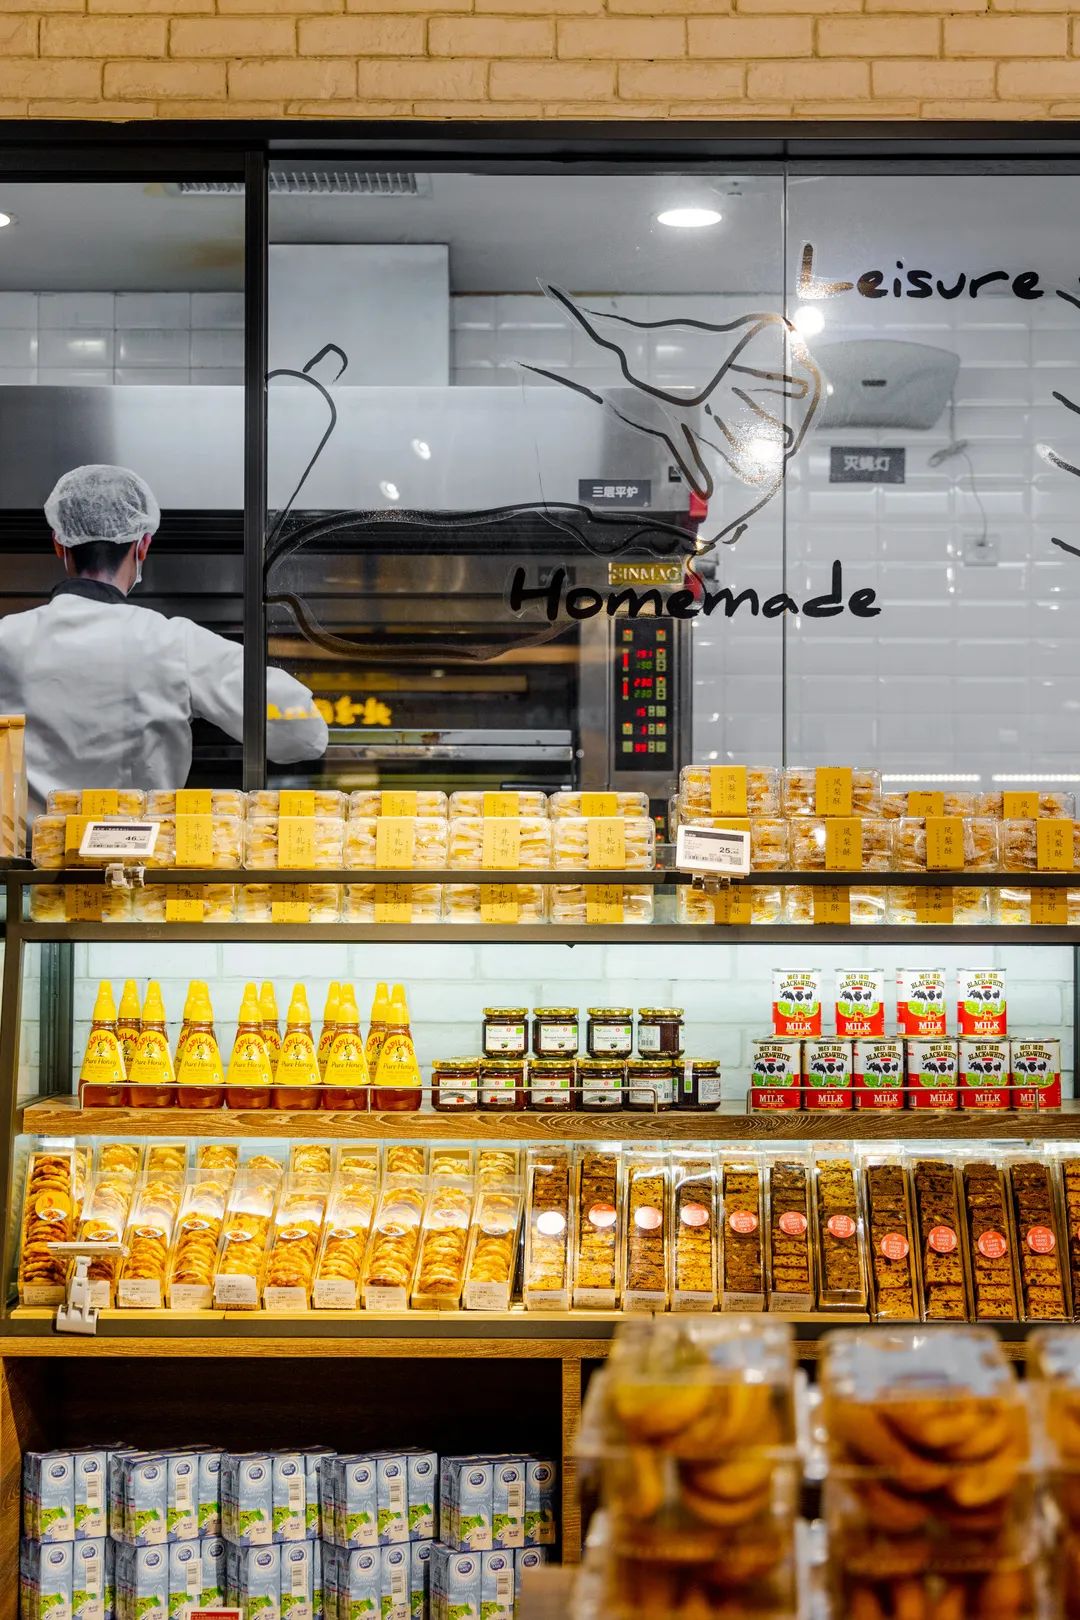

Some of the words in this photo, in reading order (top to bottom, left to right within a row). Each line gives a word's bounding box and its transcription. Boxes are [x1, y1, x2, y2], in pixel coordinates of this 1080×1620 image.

[801, 242, 1045, 299] Leisure
[592, 486, 639, 498] 三层平炉
[510, 560, 883, 619] Homemade
[786, 1021, 812, 1031] MILK
[845, 1021, 872, 1031] MILK
[918, 1021, 942, 1030] MILK
[973, 1021, 1000, 1030] MILK
[88, 1035, 116, 1051] CAPILANO
[137, 1036, 165, 1052] CAPILANO
[186, 1037, 216, 1053] CAPILANO
[235, 1039, 265, 1055] CAPILANO
[283, 1039, 313, 1054] CAPILANO
[333, 1039, 363, 1054] CAPILANO
[384, 1040, 414, 1056] CAPILANO
[84, 1057, 96, 1065] Pure
[96, 1057, 117, 1066] Honey
[147, 1059, 167, 1068] Honey
[197, 1061, 217, 1070] Honey
[246, 1061, 266, 1071] Honey
[294, 1061, 314, 1070] Honey
[345, 1061, 364, 1071] Honey
[397, 1063, 416, 1073] Honey
[758, 1094, 785, 1103] MILK
[817, 1094, 844, 1103] MILK
[873, 1093, 899, 1102] MILK
[929, 1093, 954, 1102] MILK
[974, 1093, 1001, 1102] MILK
